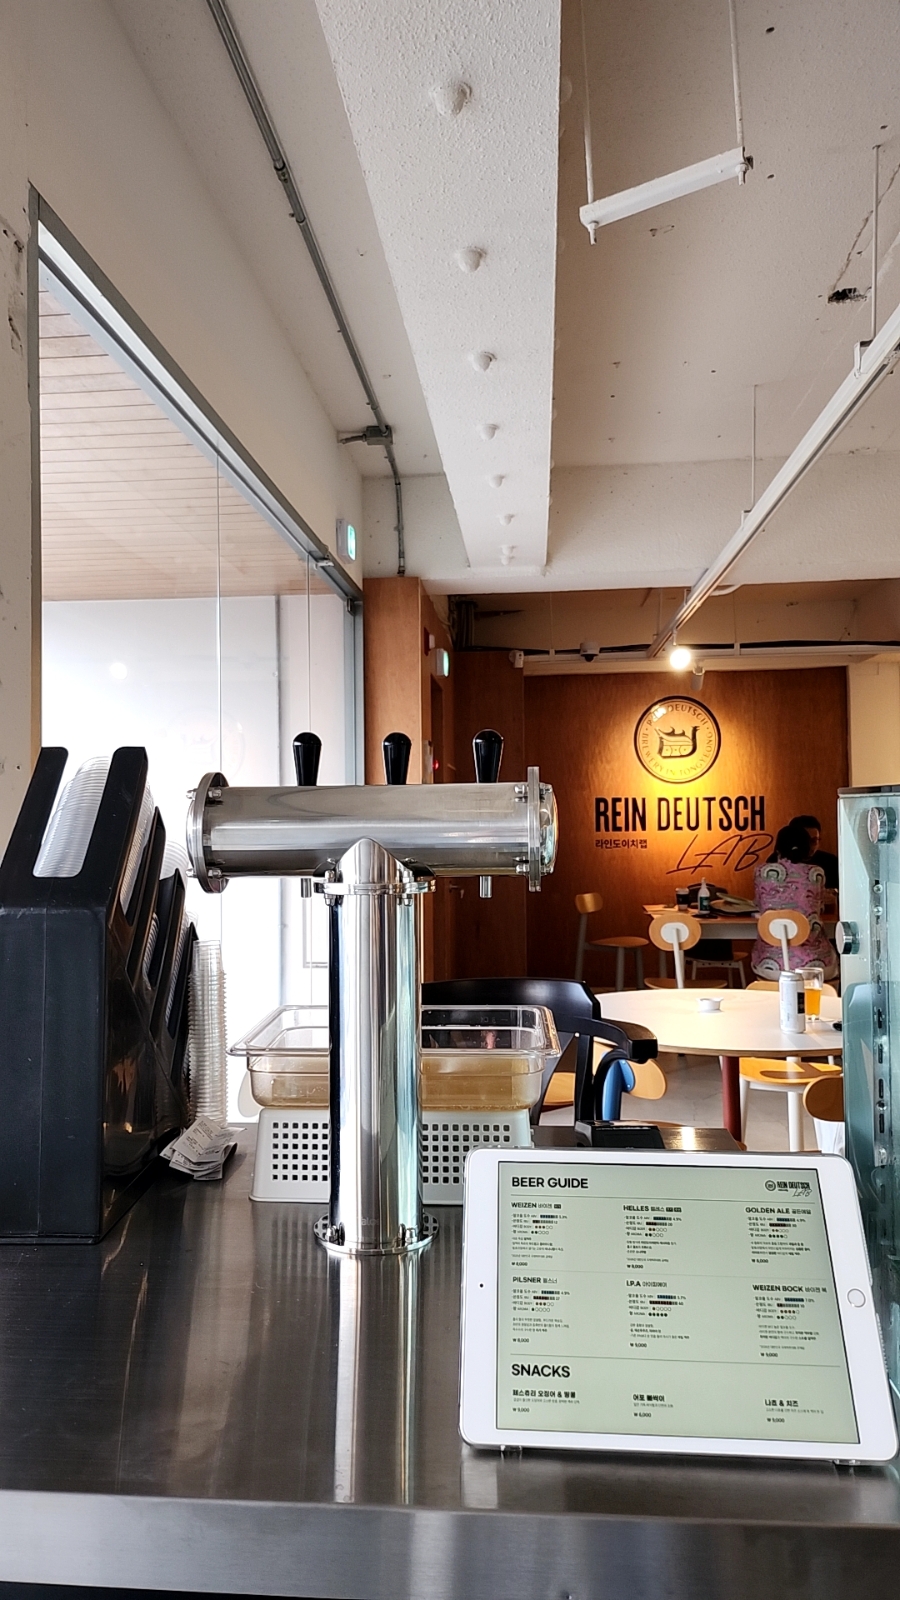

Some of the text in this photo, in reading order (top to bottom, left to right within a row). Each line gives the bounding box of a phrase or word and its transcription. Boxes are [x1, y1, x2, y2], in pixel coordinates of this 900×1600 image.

[667, 704, 708, 726] DEUTSCH
[595, 795, 765, 832] REIN DEUTSCH
[595, 839, 648, 849] 라인도이치랩
[666, 833, 774, 875] LAB
[512, 1177, 589, 1189] BEER GUIDE
[511, 1363, 571, 1378] SNACKS
[538, 1390, 556, 1398] 오징어
[786, 1400, 799, 1408] 치즈
